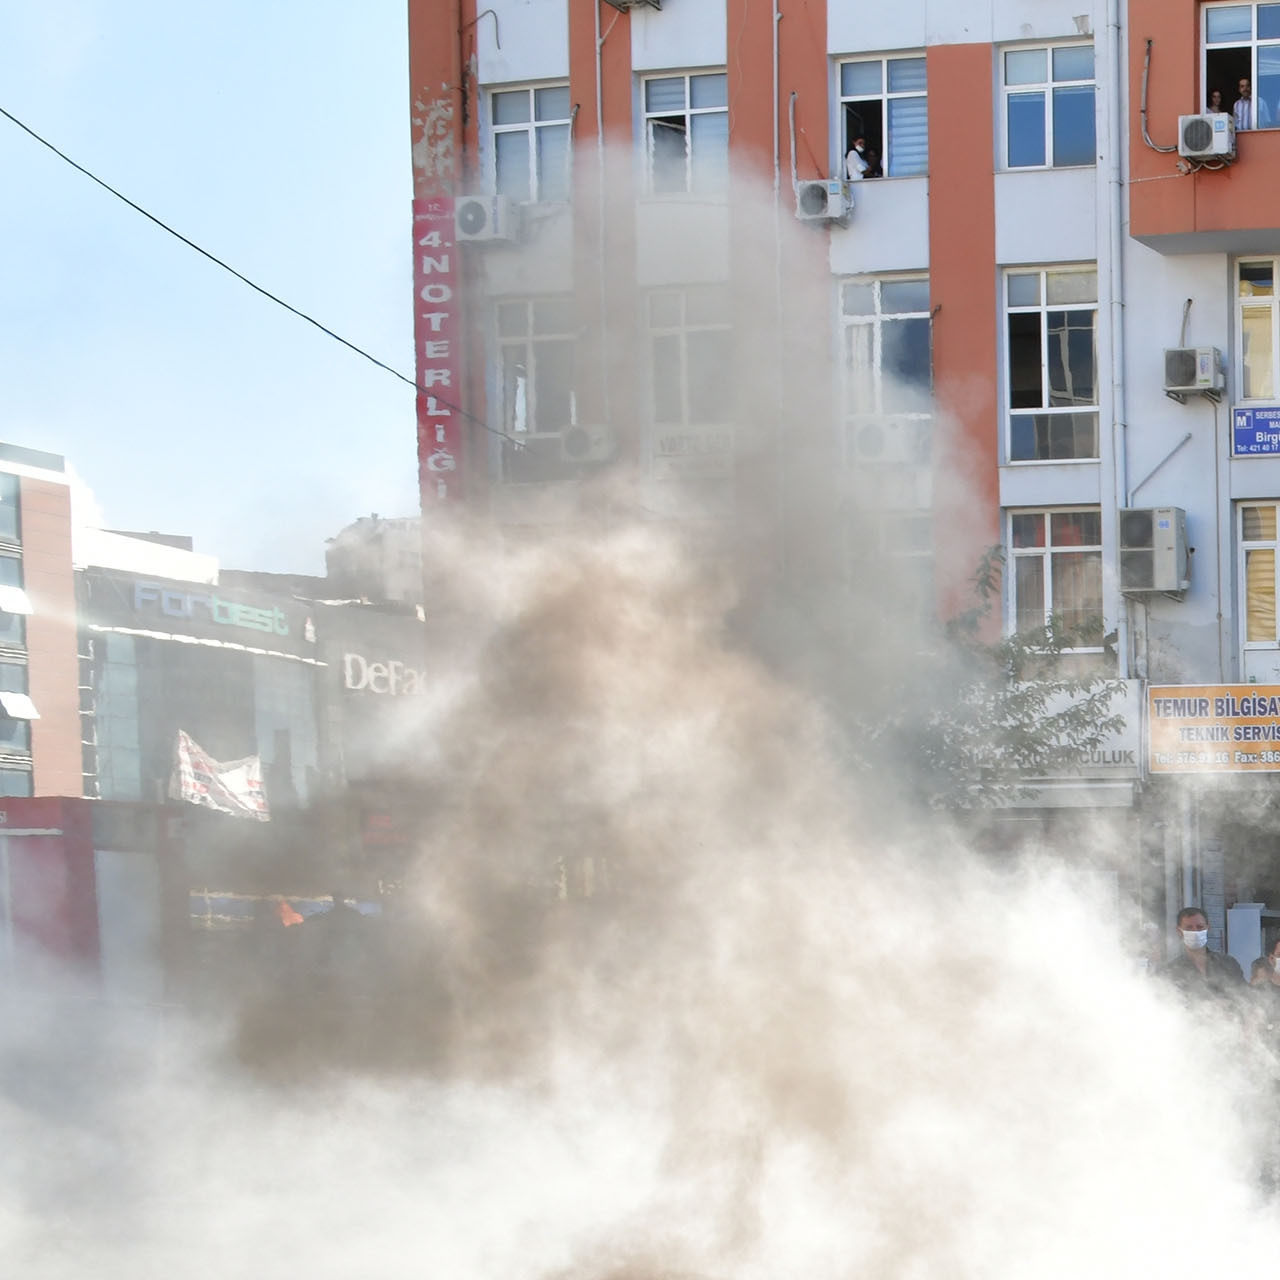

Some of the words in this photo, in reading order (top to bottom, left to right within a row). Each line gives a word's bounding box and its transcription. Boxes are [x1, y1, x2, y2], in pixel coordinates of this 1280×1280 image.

[1153, 697, 1211, 719] TEMUR
[1178, 723, 1231, 742] TEKNİK
[1234, 751, 1258, 763] Fax:
[1260, 750, 1280, 763] 386
